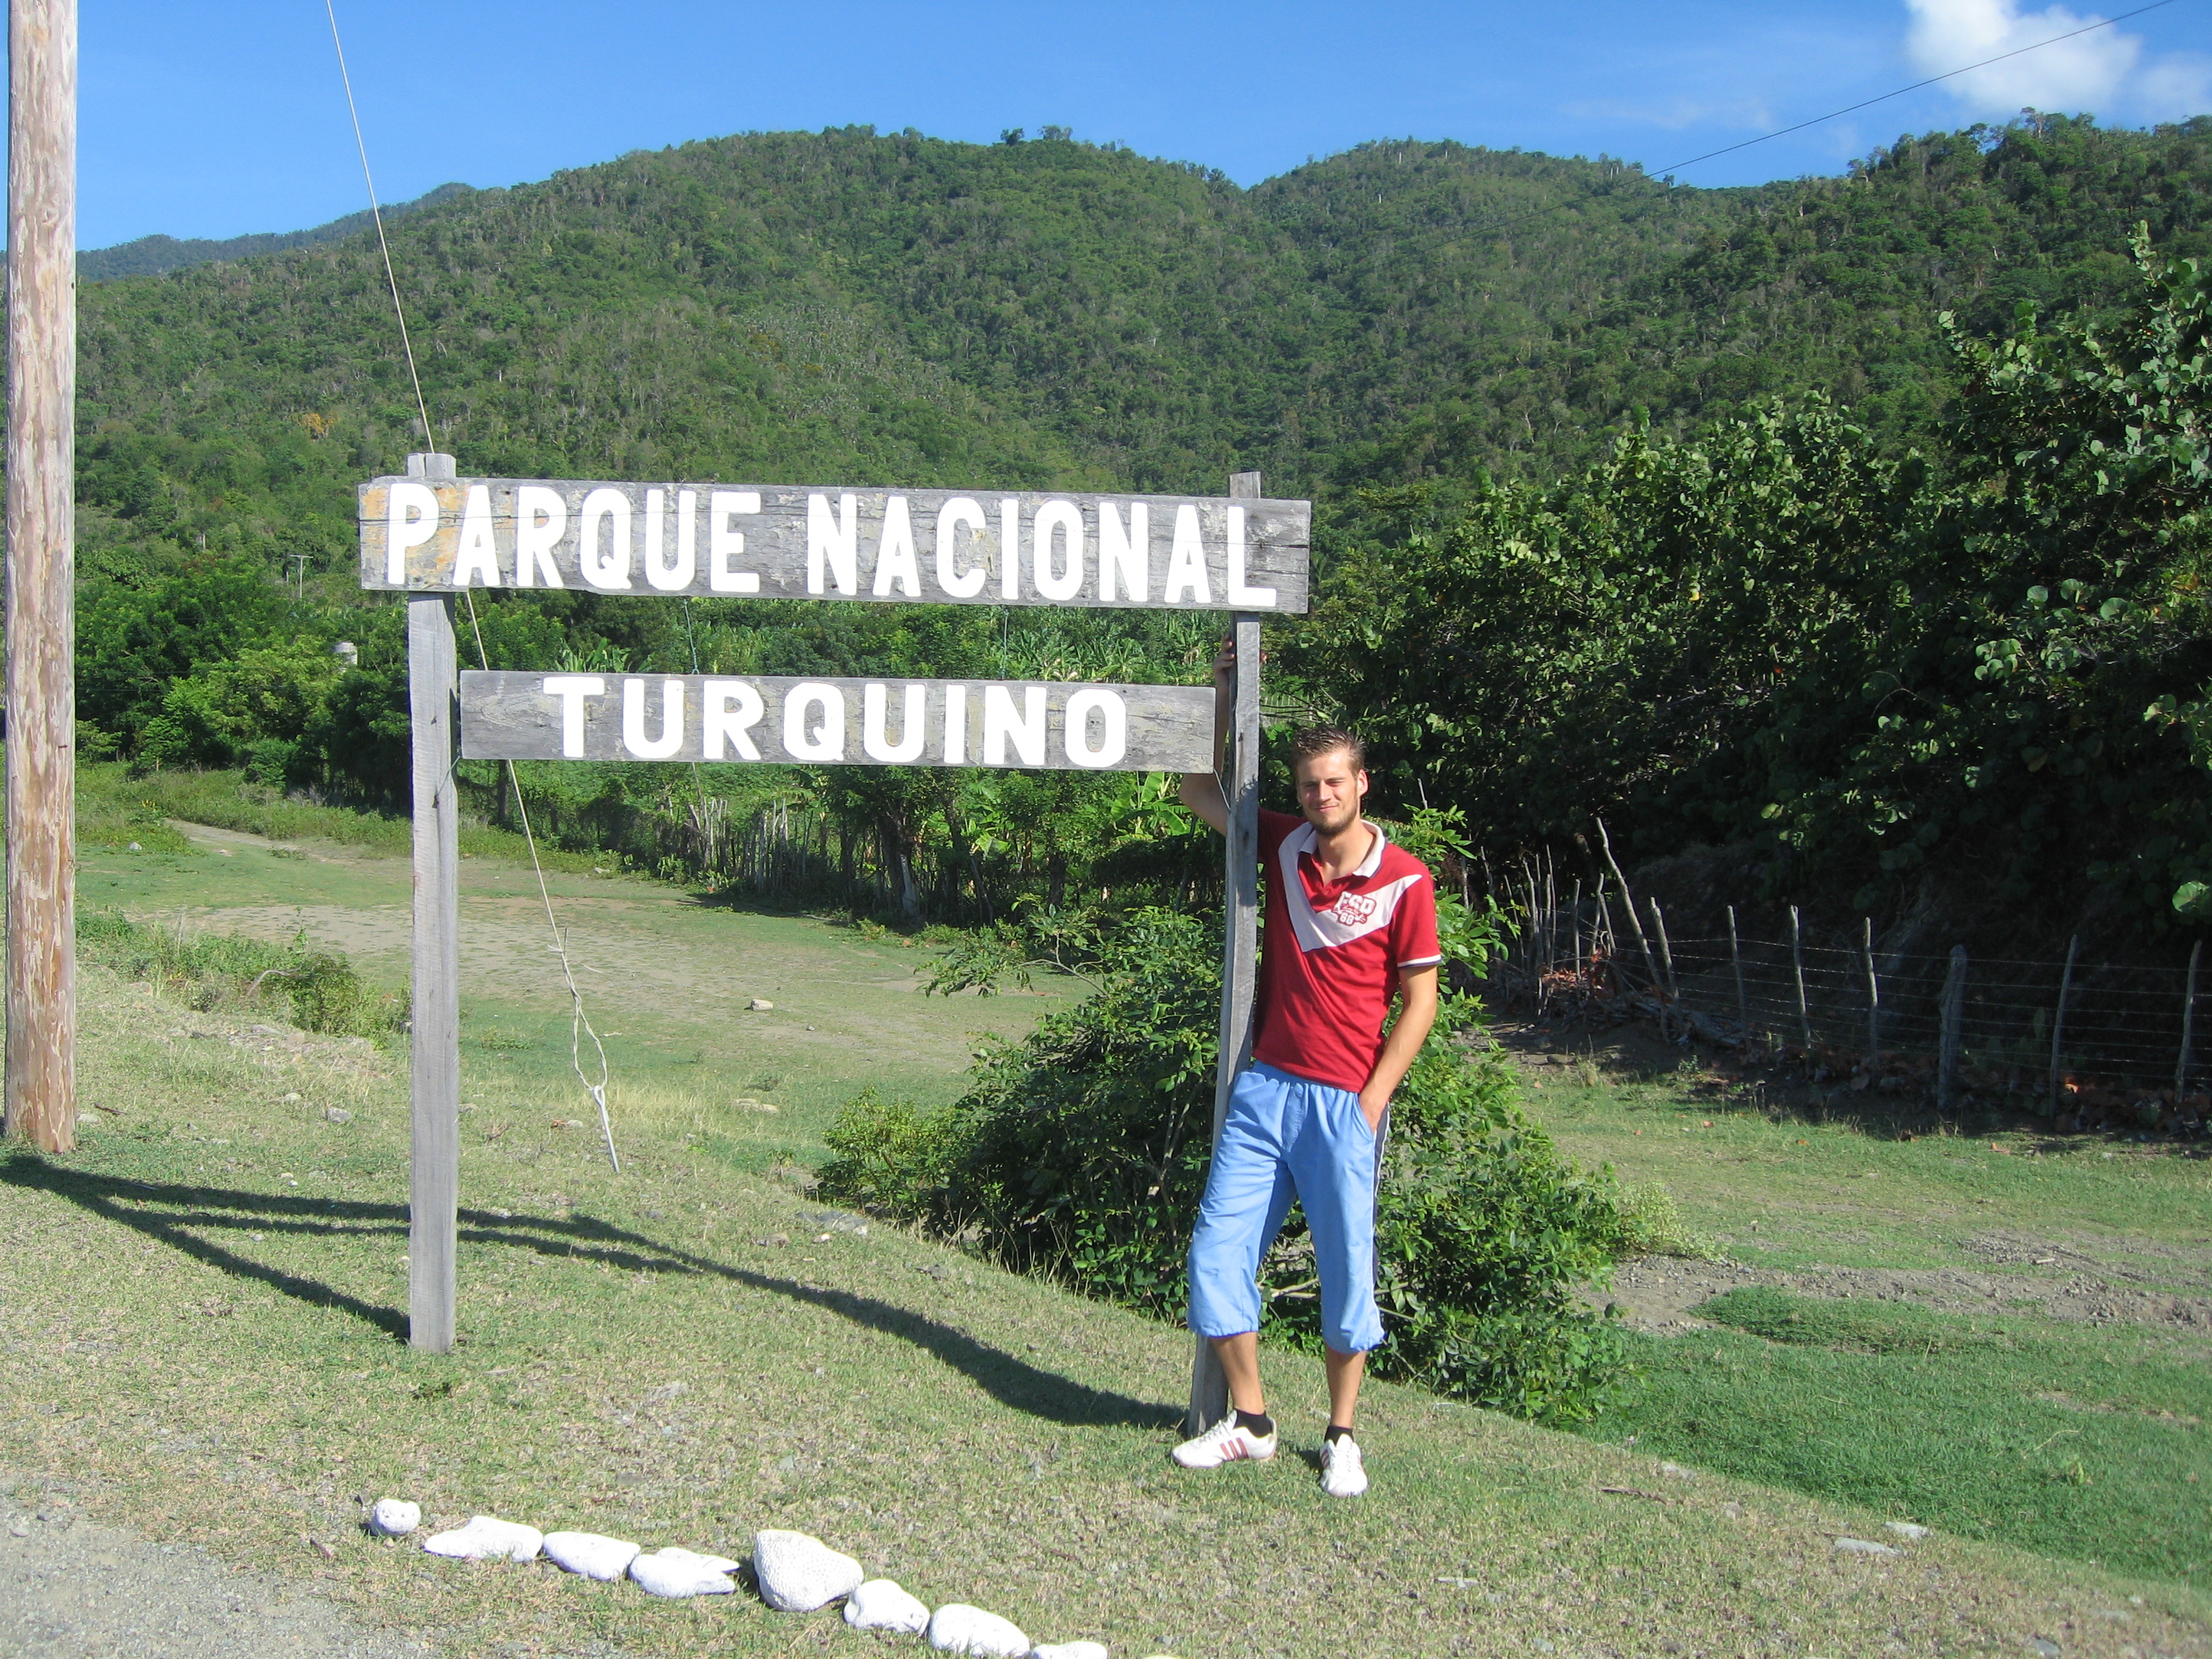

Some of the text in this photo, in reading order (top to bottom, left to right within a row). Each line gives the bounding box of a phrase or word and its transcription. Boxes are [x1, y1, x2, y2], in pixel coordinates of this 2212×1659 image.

[387, 483, 1277, 607] PARQUE NACIONAL
[543, 676, 1127, 768] TURQUINO
